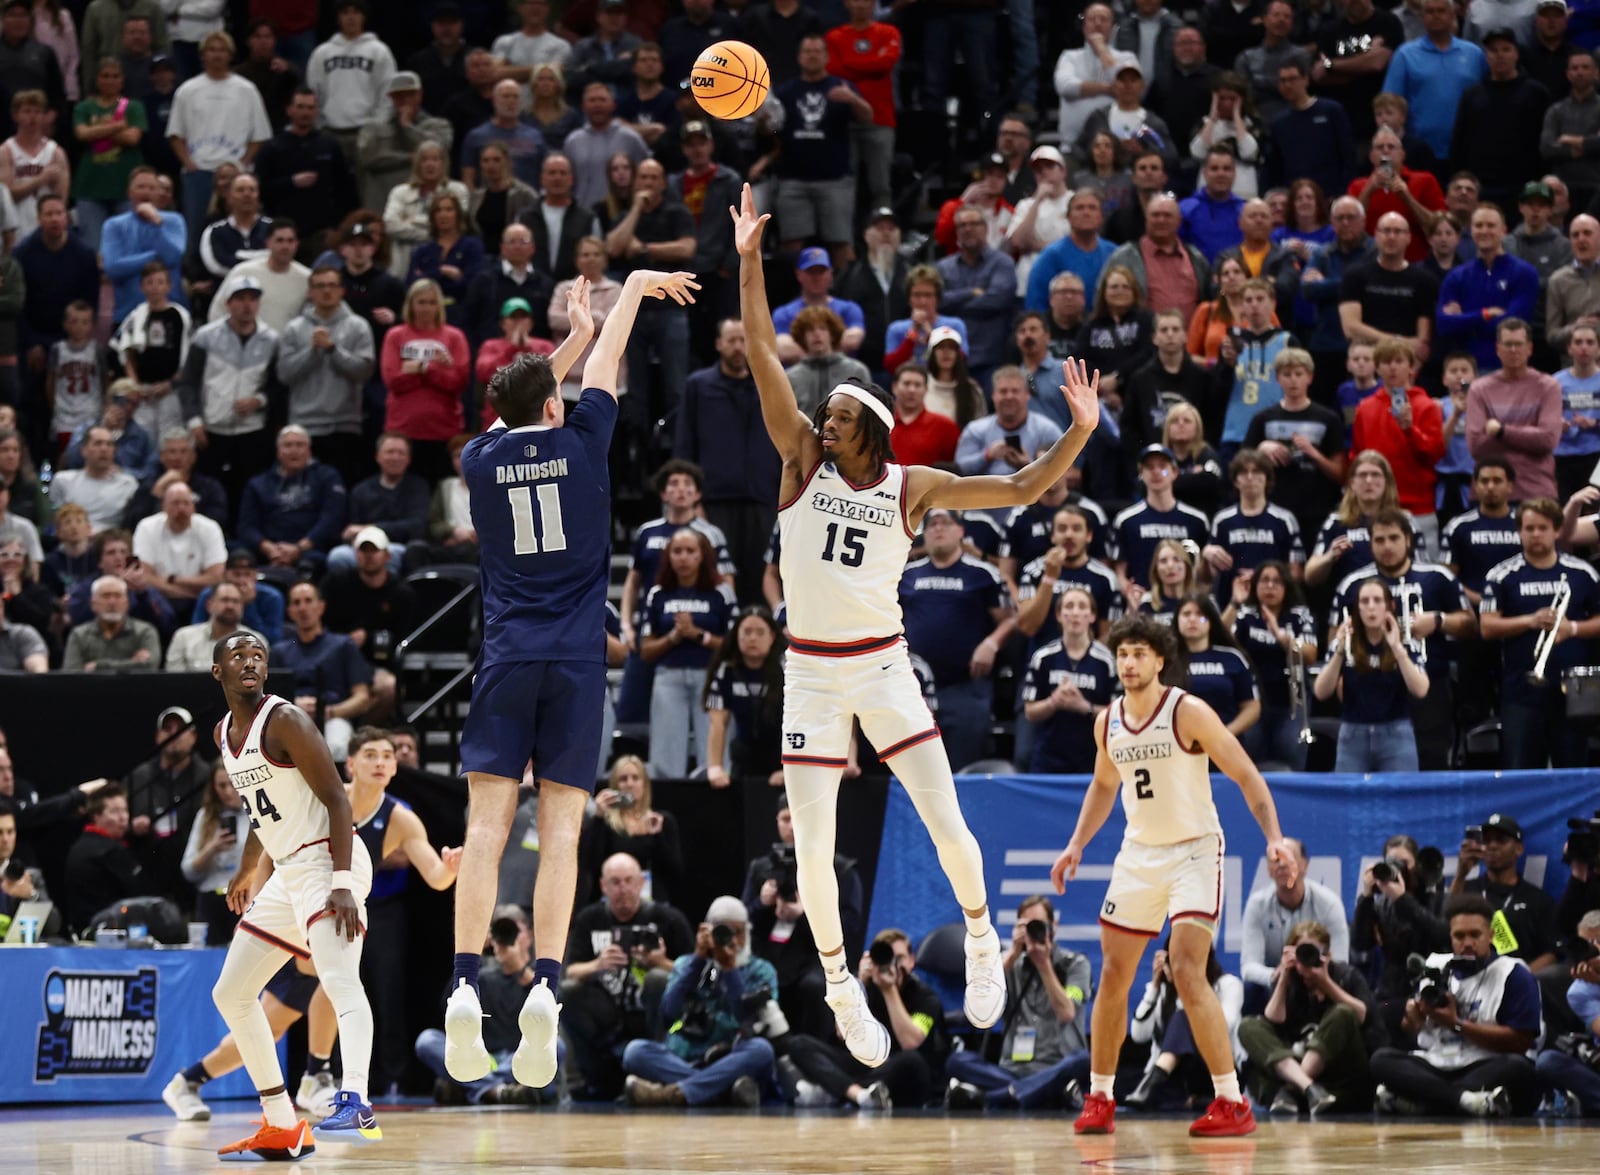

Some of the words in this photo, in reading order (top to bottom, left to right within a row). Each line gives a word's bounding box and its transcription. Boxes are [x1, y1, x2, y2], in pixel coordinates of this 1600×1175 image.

[496, 458, 568, 484] DAVIDSON
[508, 483, 567, 555] 11
[812, 492, 895, 528] DAYTON
[821, 522, 868, 568] 15
[1140, 523, 1188, 539] NEVADA
[1229, 529, 1274, 545] NEVADA
[1471, 530, 1520, 545] NEVADA
[914, 575, 964, 591] NEVADA
[663, 600, 710, 614] NEVADA
[1113, 743, 1172, 765] DAYTON
[1134, 768, 1154, 800] 2
[240, 788, 282, 830] 24
[65, 978, 125, 1018] MARCH
[72, 1019, 156, 1059] MADNESS
